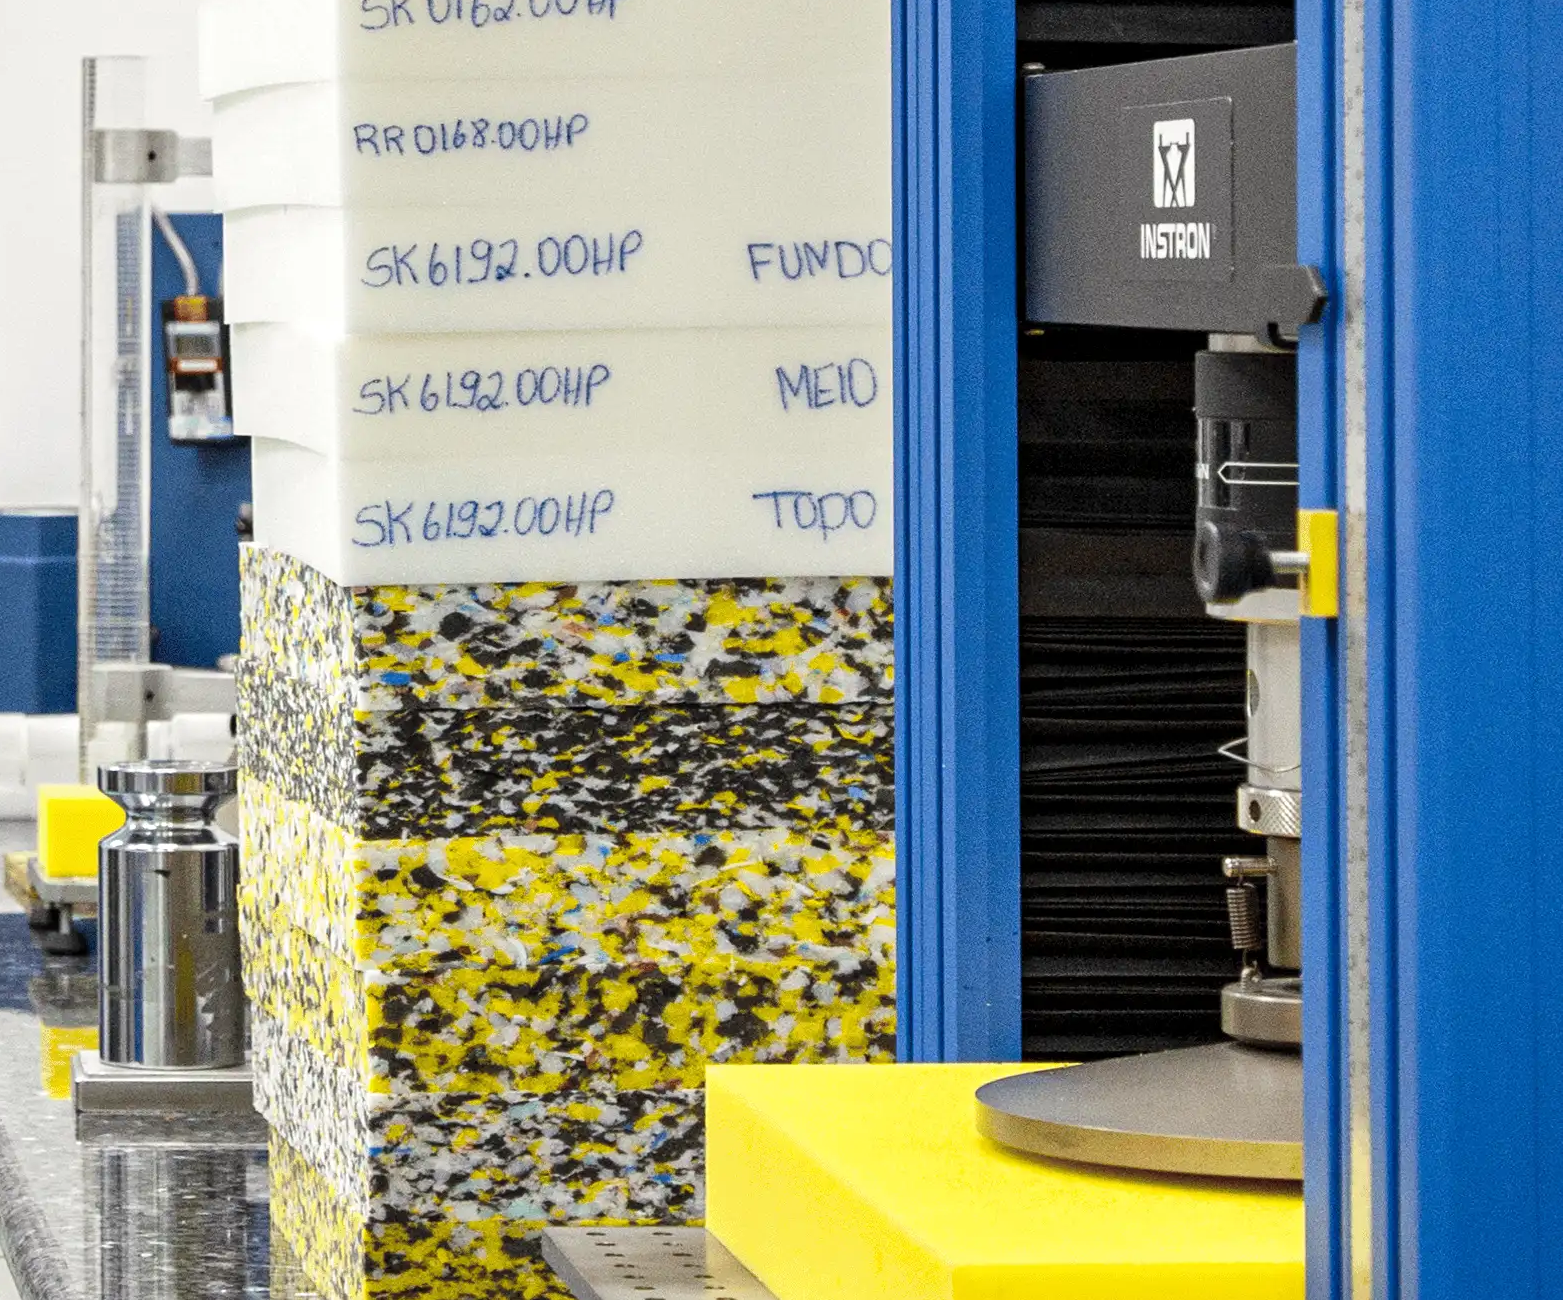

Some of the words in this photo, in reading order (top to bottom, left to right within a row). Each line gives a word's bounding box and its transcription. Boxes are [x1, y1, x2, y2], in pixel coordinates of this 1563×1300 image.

[746, 237, 893, 282] FUNDO
[1140, 222, 1211, 259] INSTRON
[774, 357, 878, 412] MEIO
[751, 489, 878, 542] TOPO
